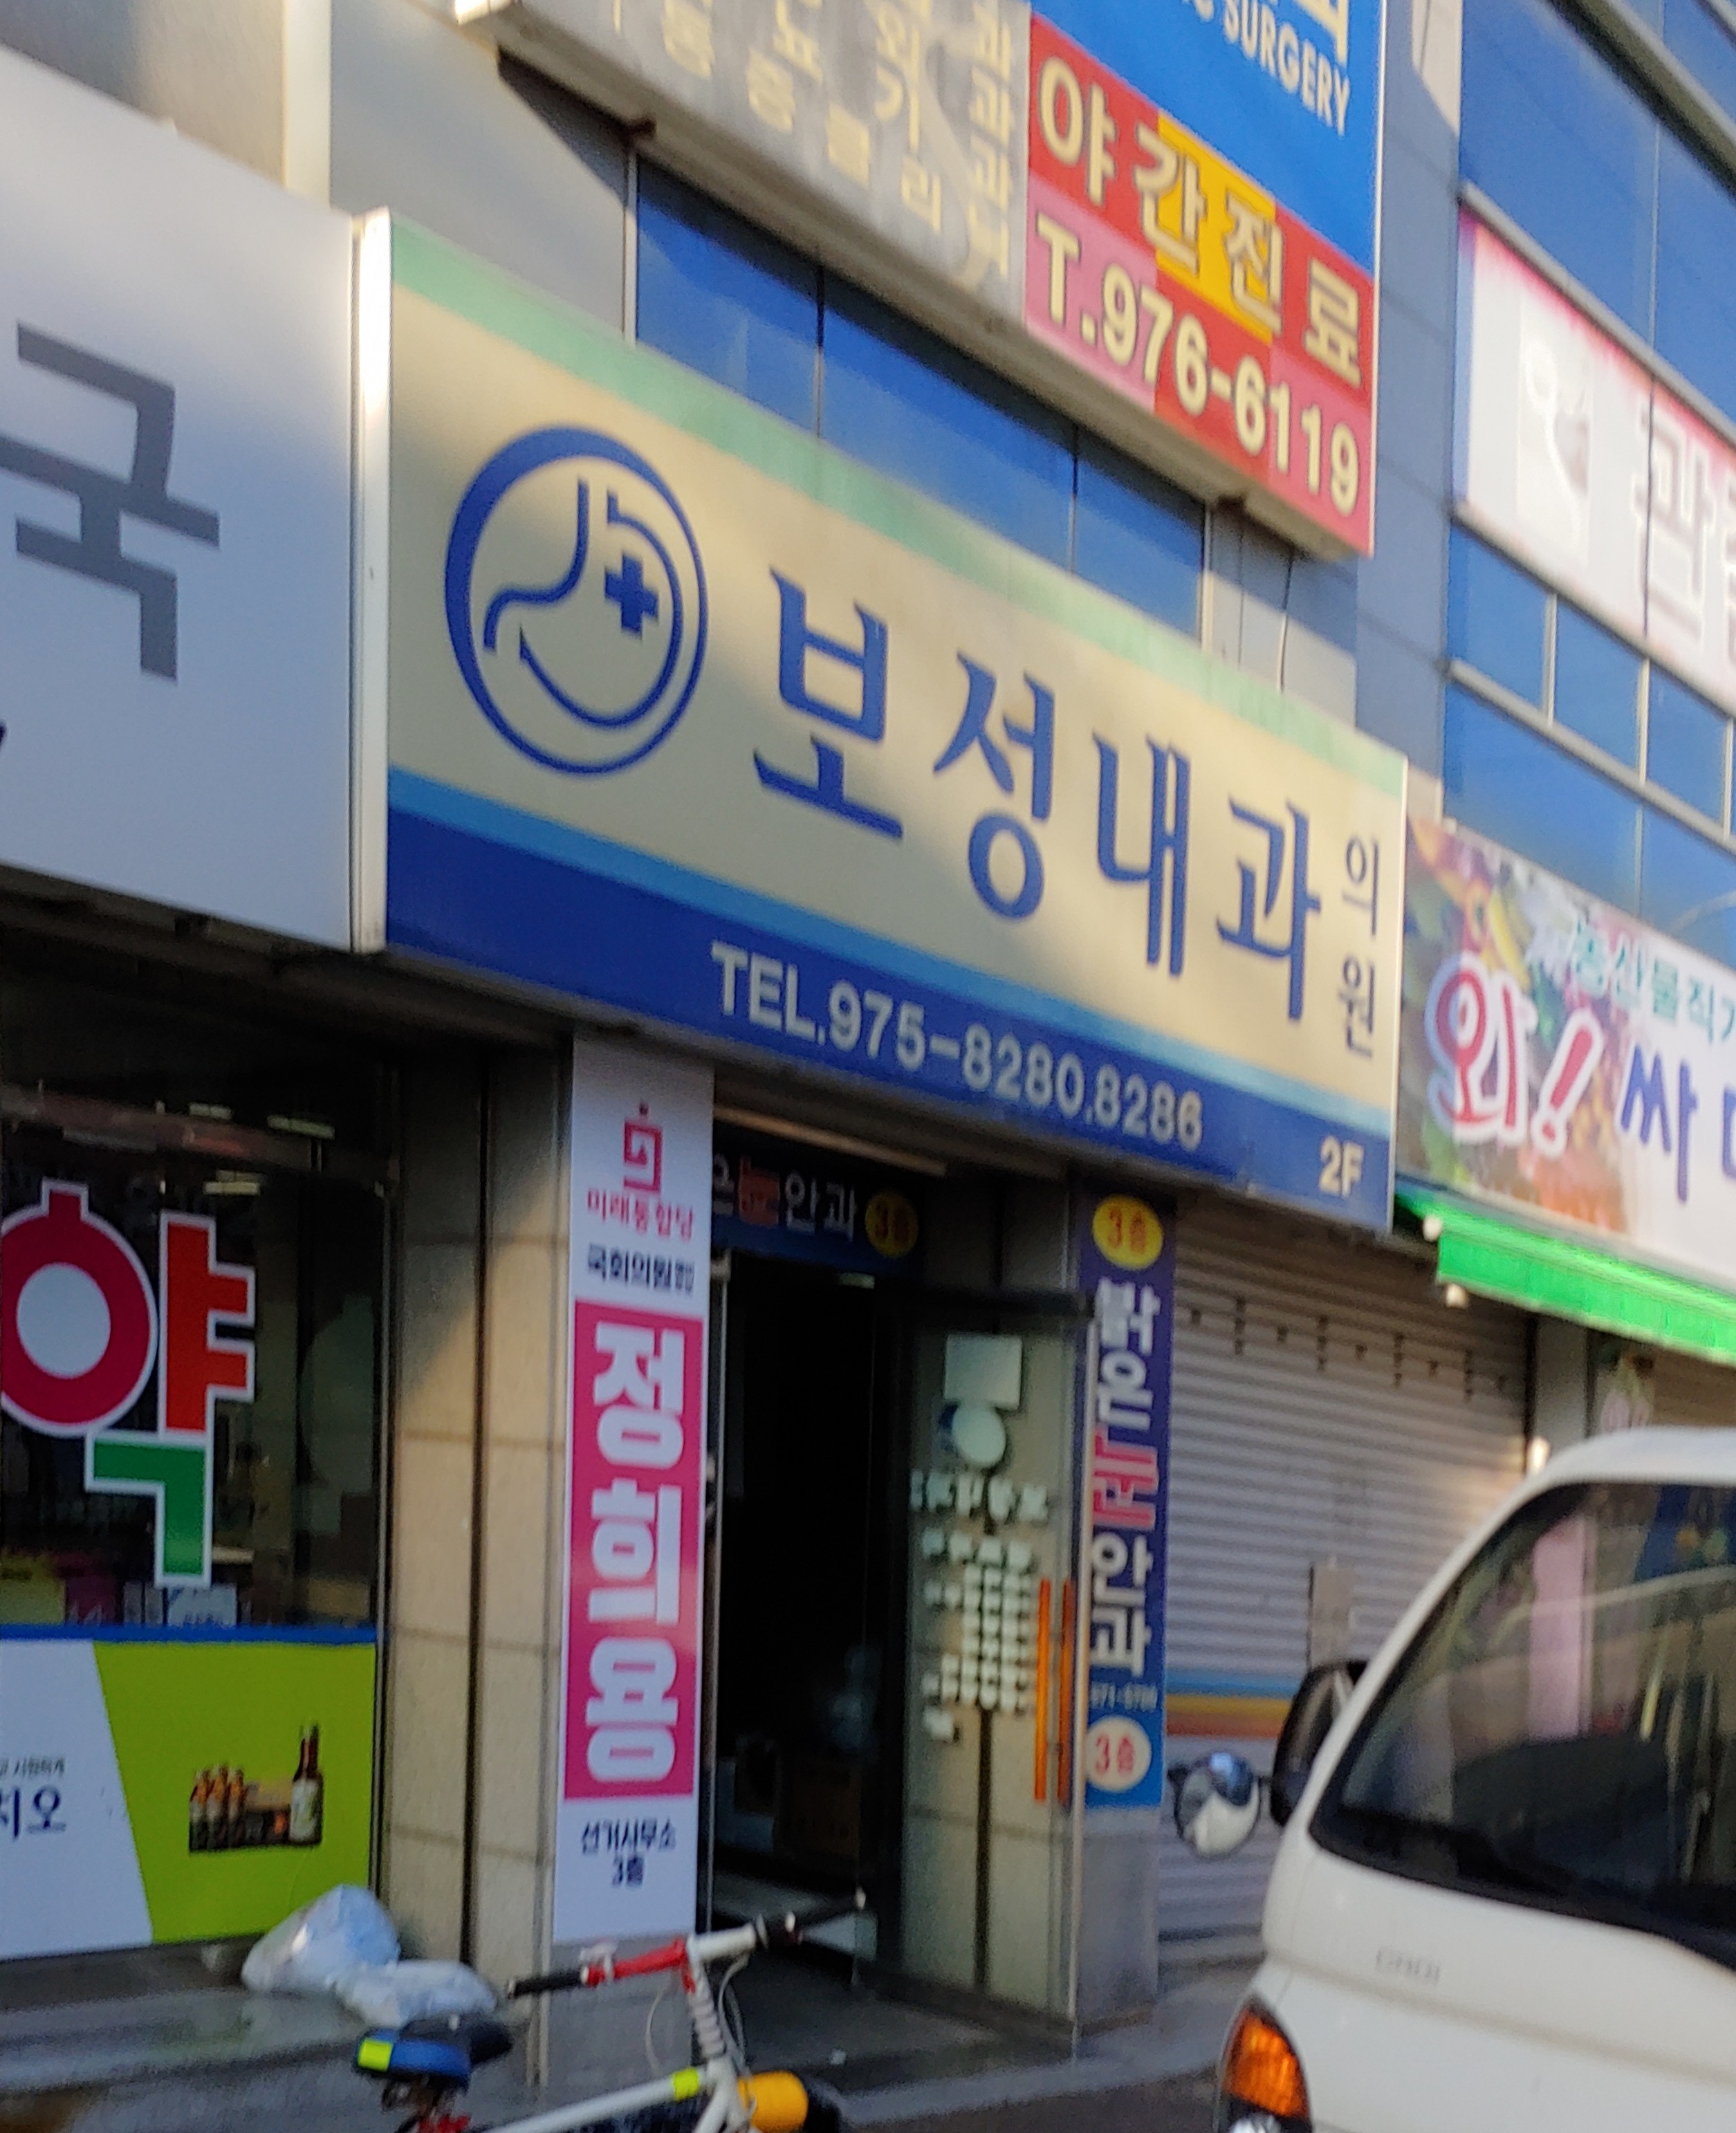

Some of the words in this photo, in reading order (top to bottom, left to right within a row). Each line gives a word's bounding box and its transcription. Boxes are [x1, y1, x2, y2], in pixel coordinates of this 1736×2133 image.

[1038, 56, 1362, 389] 야간진료
[1223, 0, 1351, 136] SURGERY
[0, 321, 220, 682] 국
[1035, 212, 1360, 517] T.976-6119
[754, 565, 1320, 1022] 보성내과
[1338, 834, 1378, 1058] 의원
[1319, 1134, 1366, 1198] 2F
[1620, 1042, 1736, 1204] 싸
[0, 1179, 255, 1589] 약
[585, 1320, 685, 1784] 정희용
